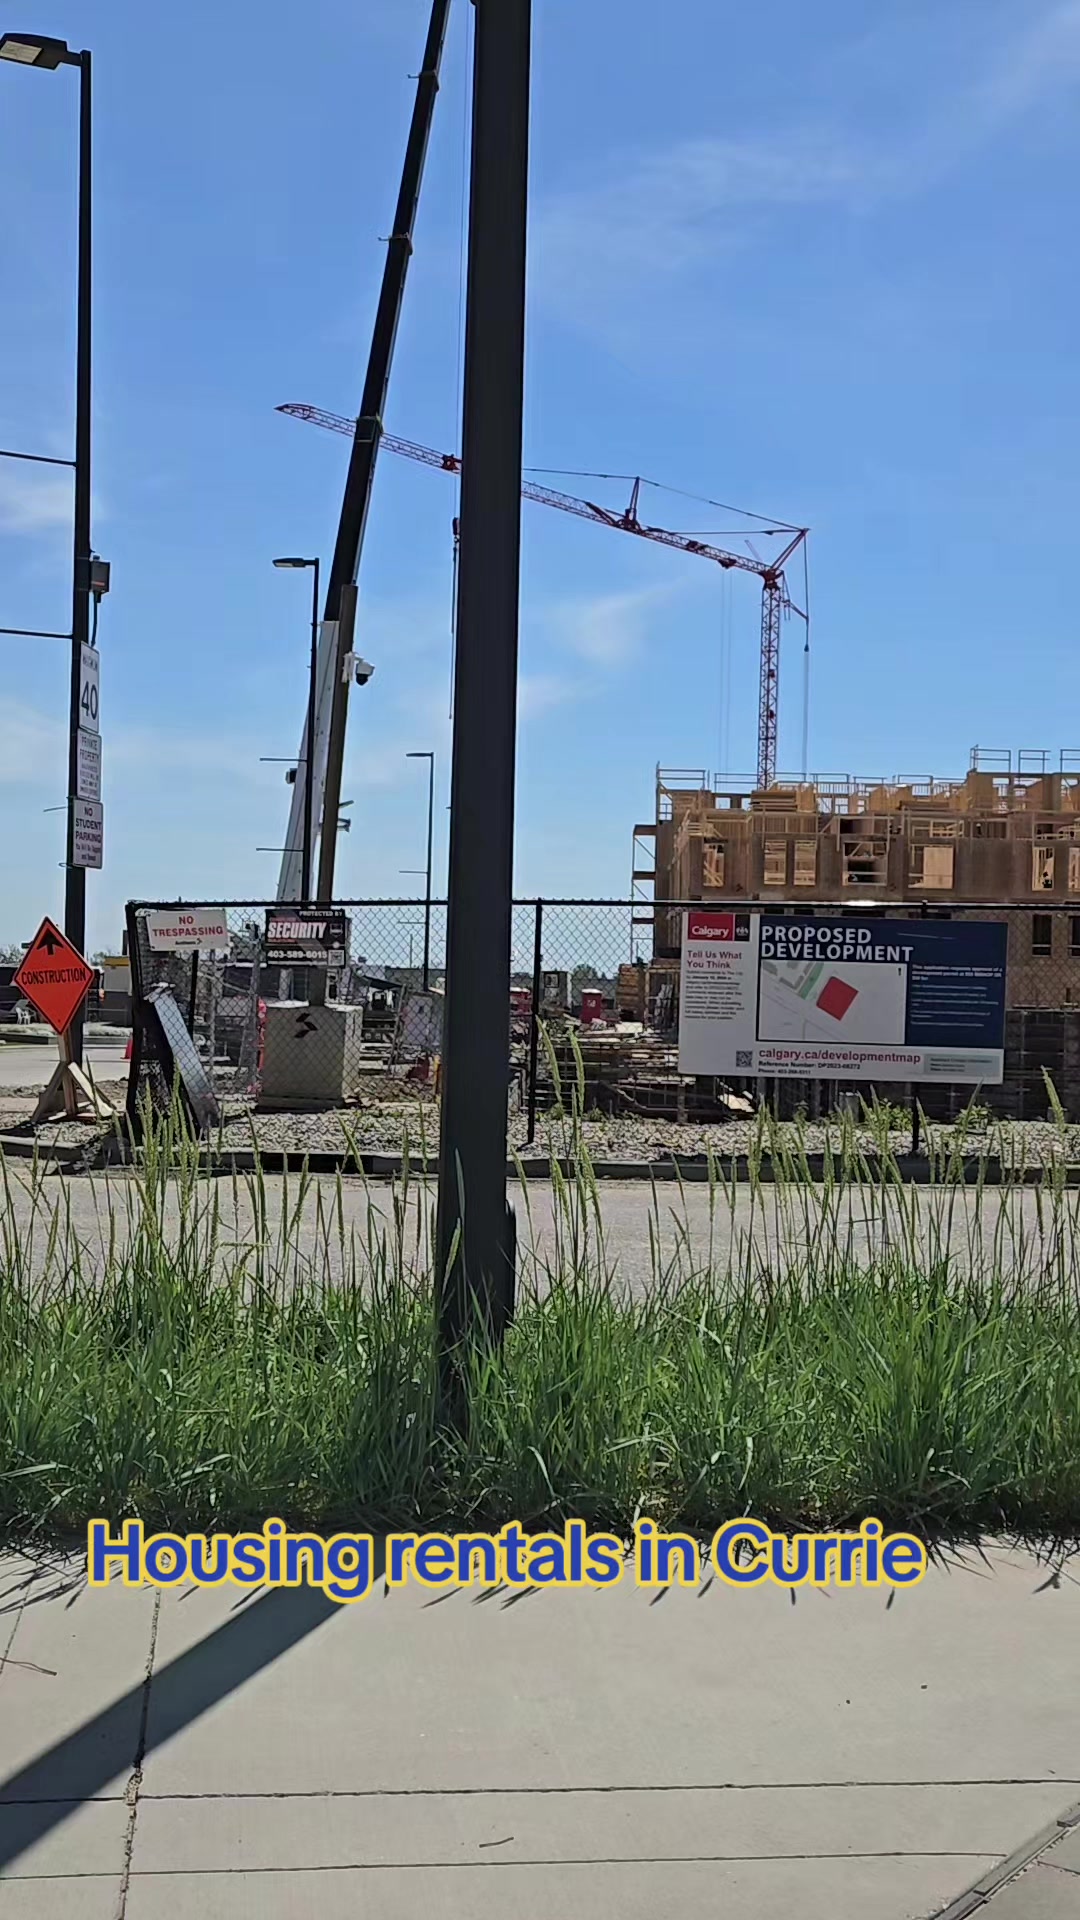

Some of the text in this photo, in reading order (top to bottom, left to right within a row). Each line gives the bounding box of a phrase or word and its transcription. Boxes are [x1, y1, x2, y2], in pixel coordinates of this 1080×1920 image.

[81, 680, 98, 720] 40
[84, 807, 93, 817] NO
[75, 818, 102, 831] STUDENT
[75, 831, 102, 843] PARKING
[178, 915, 194, 925] NO
[152, 926, 224, 937] TRESPASSING
[267, 921, 327, 939] SECURITY
[691, 925, 729, 938] Calgary
[761, 925, 872, 944] PROPOSED
[687, 950, 703, 958] Tell
[719, 951, 743, 960] What
[761, 942, 914, 962] DEVELOPMENT
[686, 960, 731, 969] You Think
[21, 967, 87, 986] CONSTRUCTION
[758, 1048, 921, 1065] calgary.ca/developmentmap
[758, 1060, 789, 1068] Reference
[790, 1061, 816, 1069] Number:
